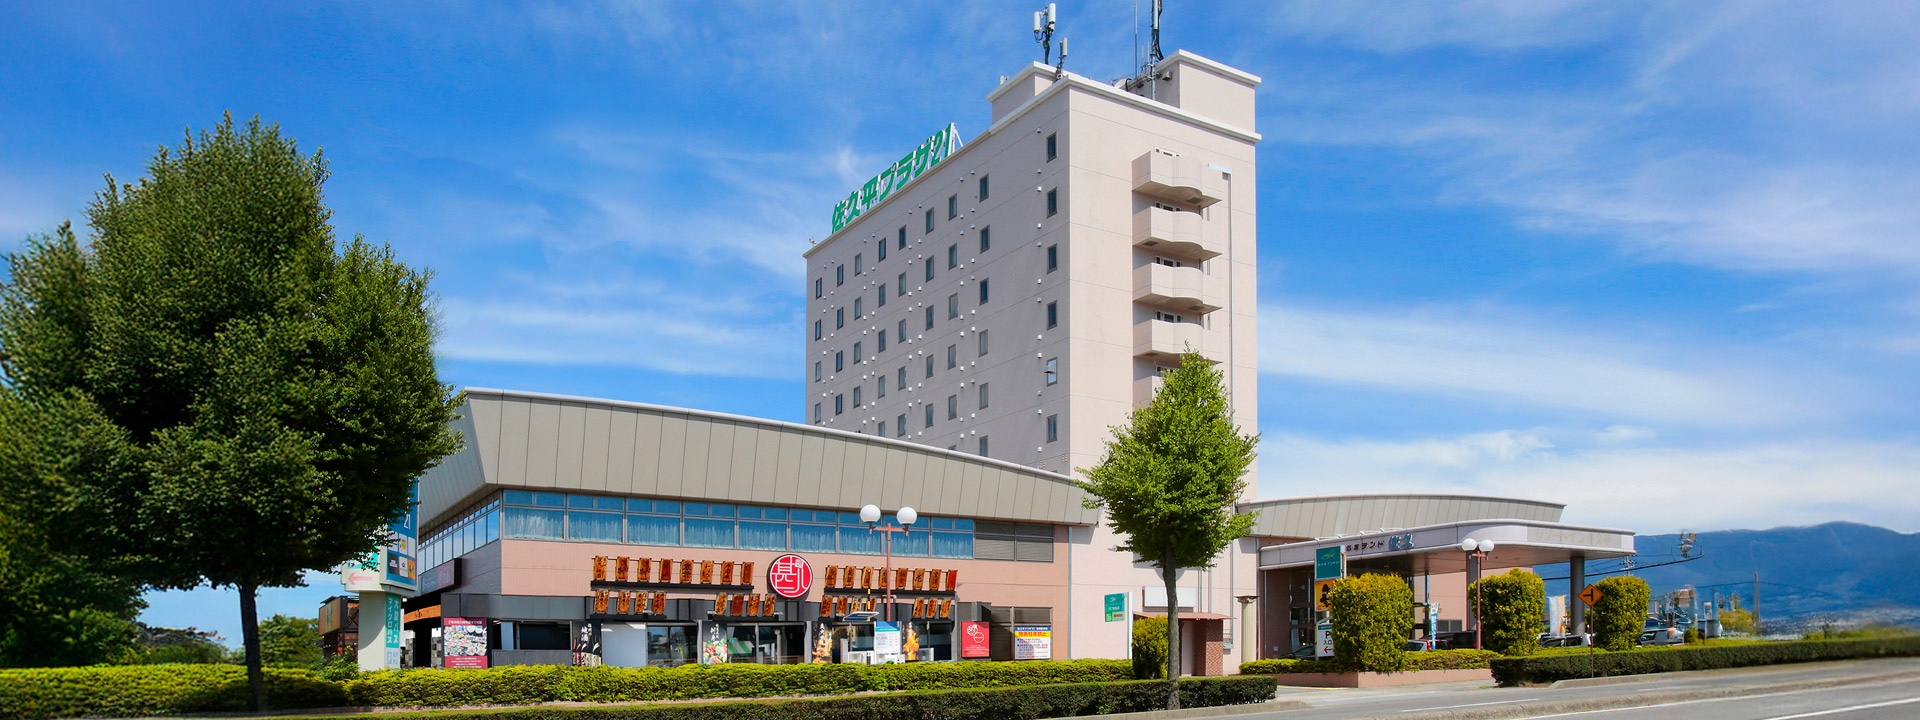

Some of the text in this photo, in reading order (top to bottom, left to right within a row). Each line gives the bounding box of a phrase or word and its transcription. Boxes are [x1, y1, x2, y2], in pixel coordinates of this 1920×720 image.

[832, 122, 954, 234] 佐久平プラザ21
